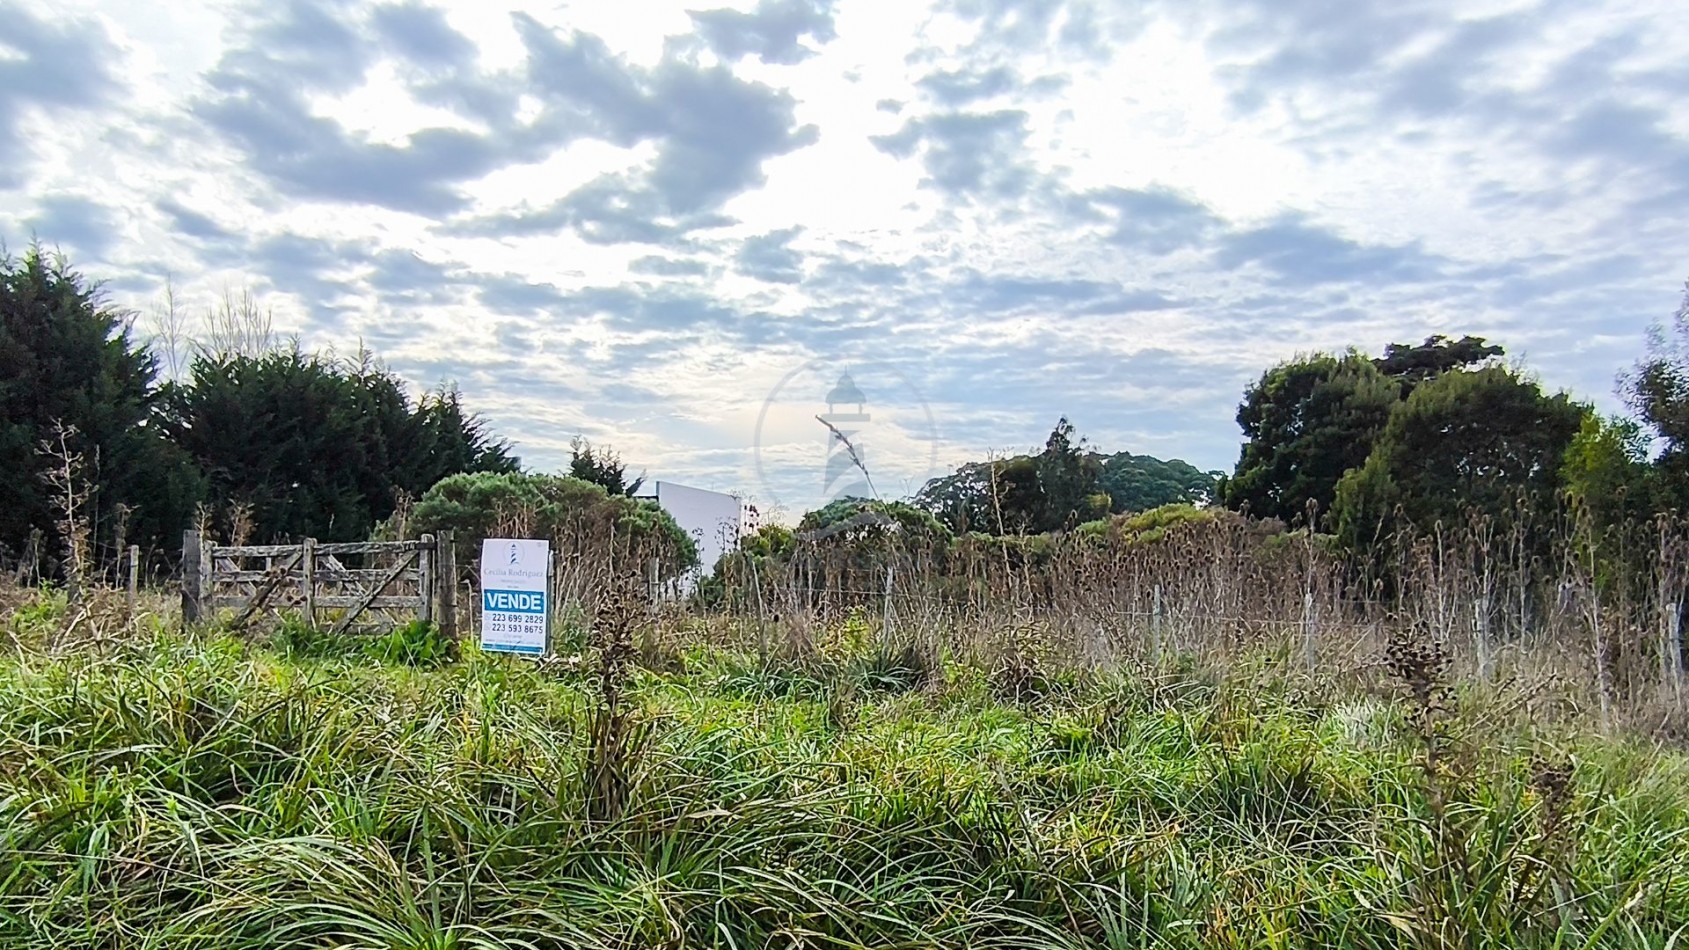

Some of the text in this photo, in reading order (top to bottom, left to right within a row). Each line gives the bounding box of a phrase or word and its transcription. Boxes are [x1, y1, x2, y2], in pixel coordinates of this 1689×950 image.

[487, 592, 542, 610] VENDE
[492, 613, 544, 624] 223 699 2829
[492, 624, 543, 634] 223 593 8675
